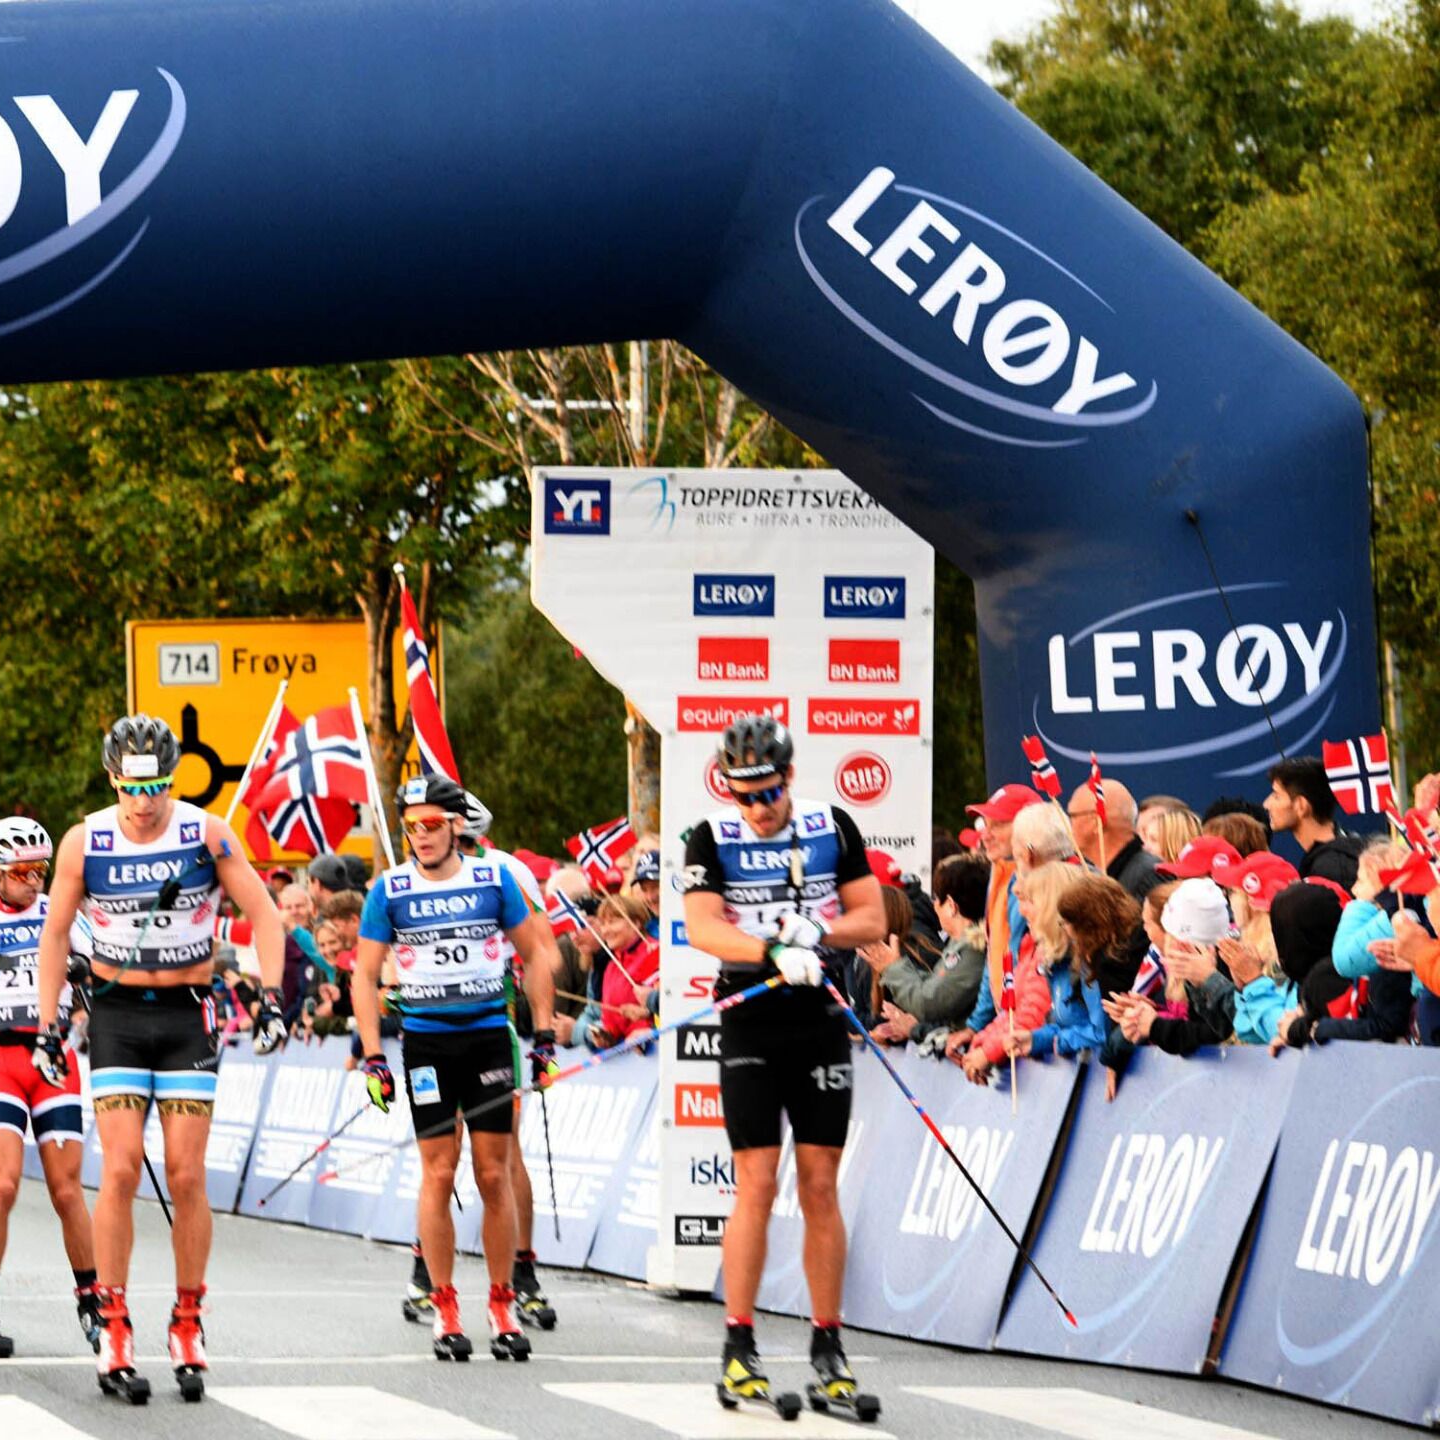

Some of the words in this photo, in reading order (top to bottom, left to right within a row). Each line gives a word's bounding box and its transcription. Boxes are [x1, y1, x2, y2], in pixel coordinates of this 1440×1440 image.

[826, 166, 1136, 416] LERØY
[554, 488, 601, 521] YT
[754, 513, 801, 528] HITRA
[700, 584, 768, 605] LERØY
[830, 586, 899, 607] LERØY
[169, 653, 210, 675] 714
[233, 649, 317, 678] Frøya
[700, 662, 724, 678] BN
[727, 662, 765, 680] Bank
[831, 665, 854, 680] BN
[858, 664, 896, 681] Bank
[1048, 619, 1333, 713] LERØY
[683, 706, 757, 727] equino
[813, 706, 887, 728] equinor
[434, 945, 468, 965] 50
[1079, 1133, 1225, 1258] LERØY
[1295, 1138, 1440, 1286] LERØY
